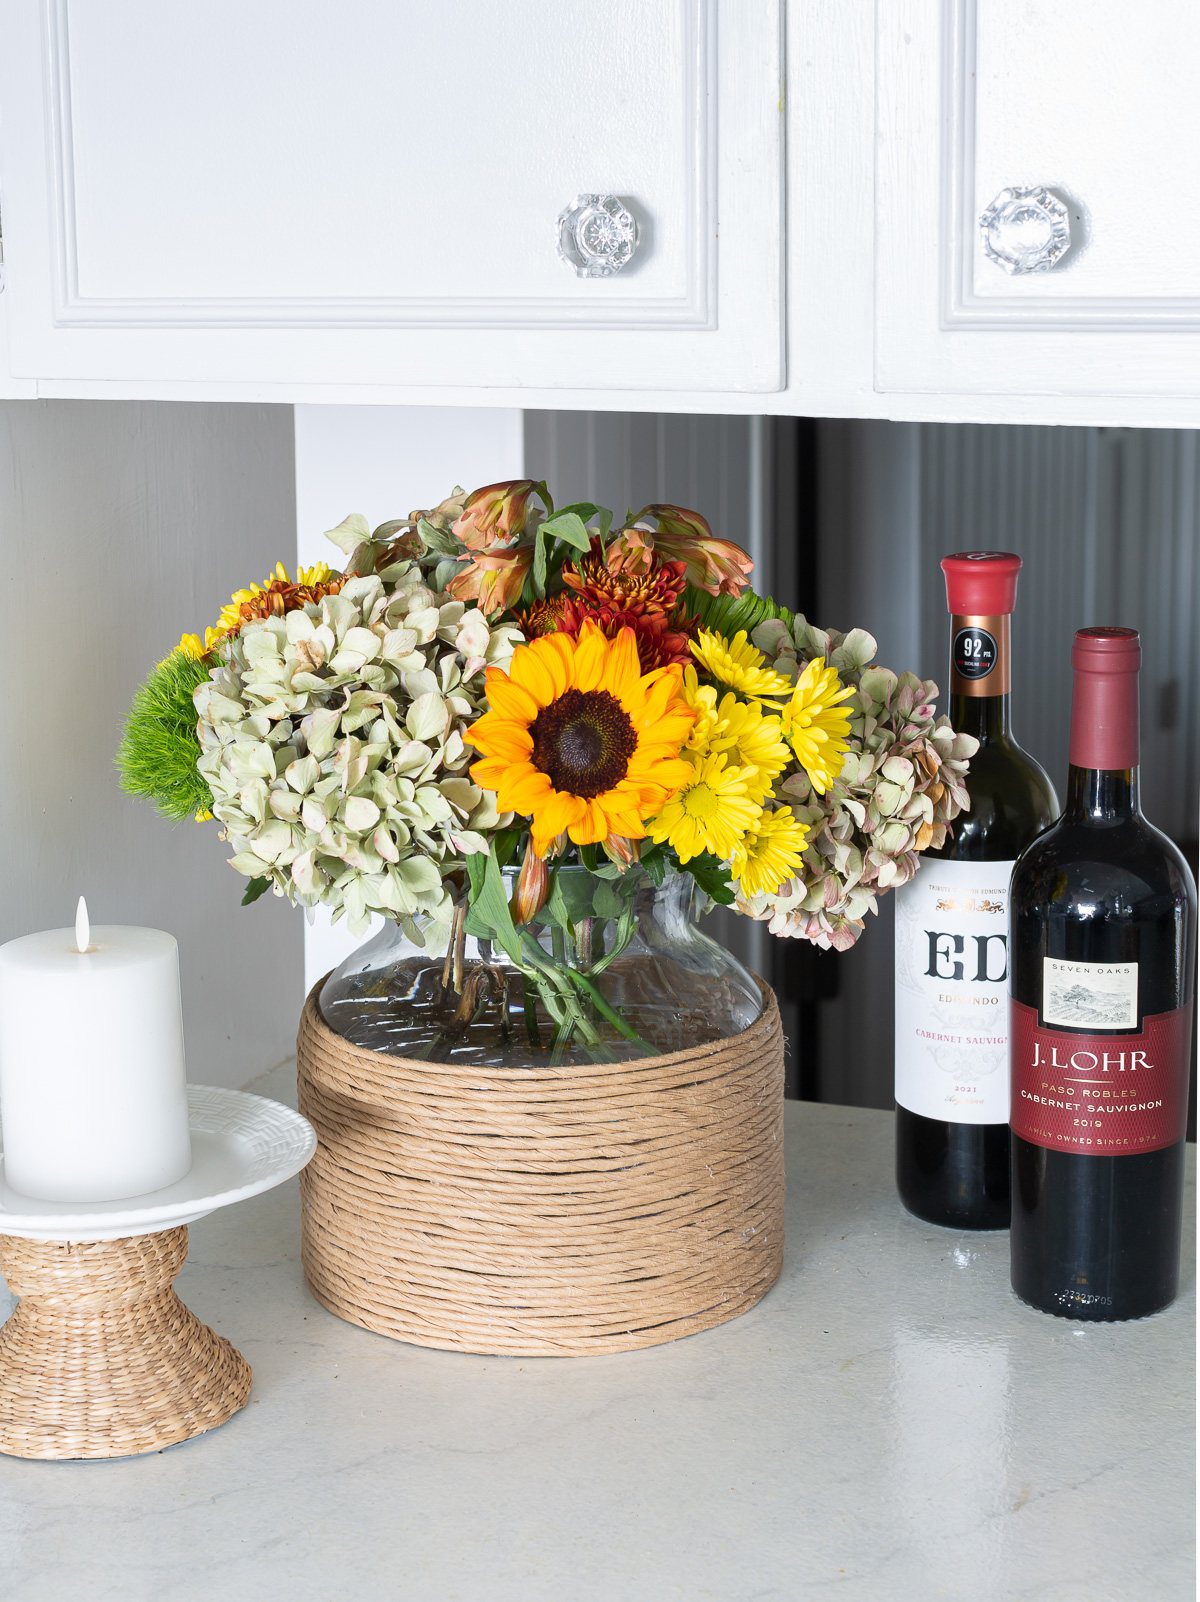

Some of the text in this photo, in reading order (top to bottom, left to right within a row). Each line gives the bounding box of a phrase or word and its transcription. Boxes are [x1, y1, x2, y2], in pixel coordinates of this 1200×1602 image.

[964, 638, 982, 658] 92
[924, 930, 1008, 982] ED
[1052, 963, 1131, 975] SEVEN OAKS
[938, 993, 999, 1006] EDNDO
[915, 1028, 963, 1043] CABERNET
[954, 1085, 977, 1093] 2021
[1040, 1082, 1137, 1098] PASO ROBLES
[1020, 1089, 1163, 1113] CABERNET SAUVIGNON
[1073, 1118, 1102, 1128] 2019
[1056, 1134, 1092, 1145] OWNED
[1133, 1135, 1158, 1145] 1974
